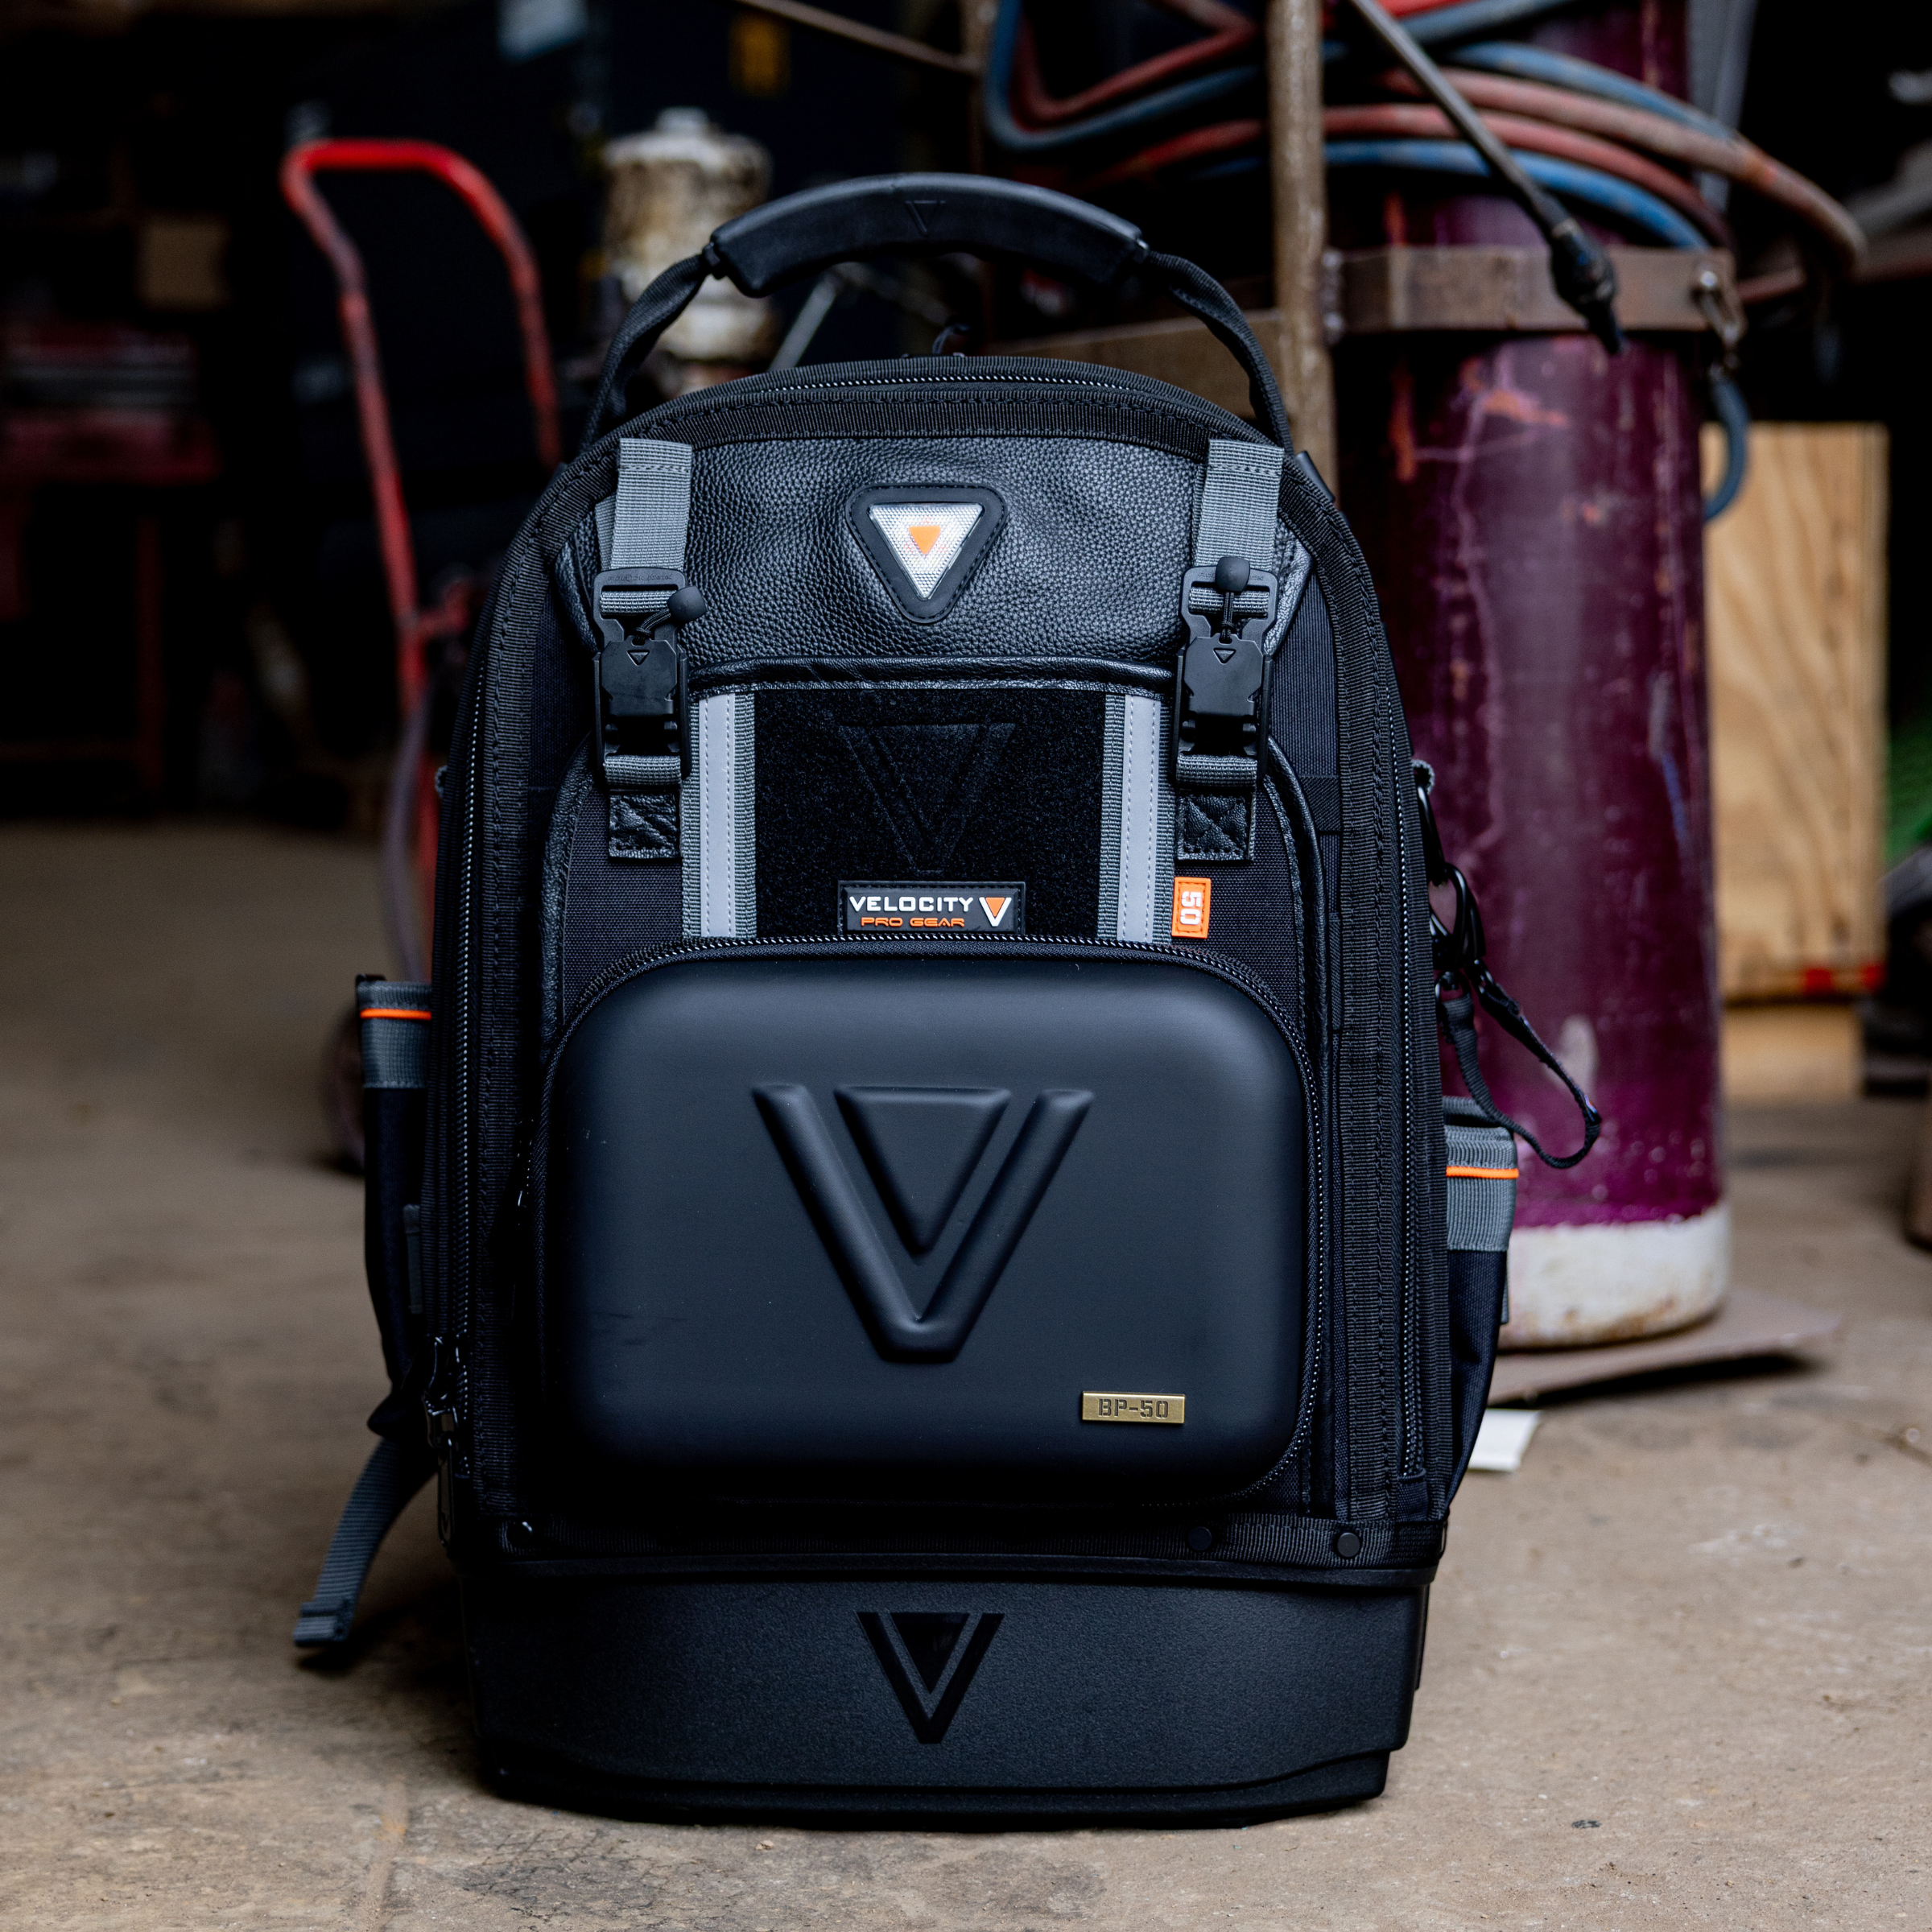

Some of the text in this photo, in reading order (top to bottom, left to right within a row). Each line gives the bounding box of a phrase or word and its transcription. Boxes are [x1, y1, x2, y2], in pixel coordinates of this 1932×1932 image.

[849, 896, 973, 912] VELOCITY
[1180, 891, 1202, 925] 50
[861, 917, 965, 927] PRO GEAR
[1098, 1398, 1169, 1418] BP-50
